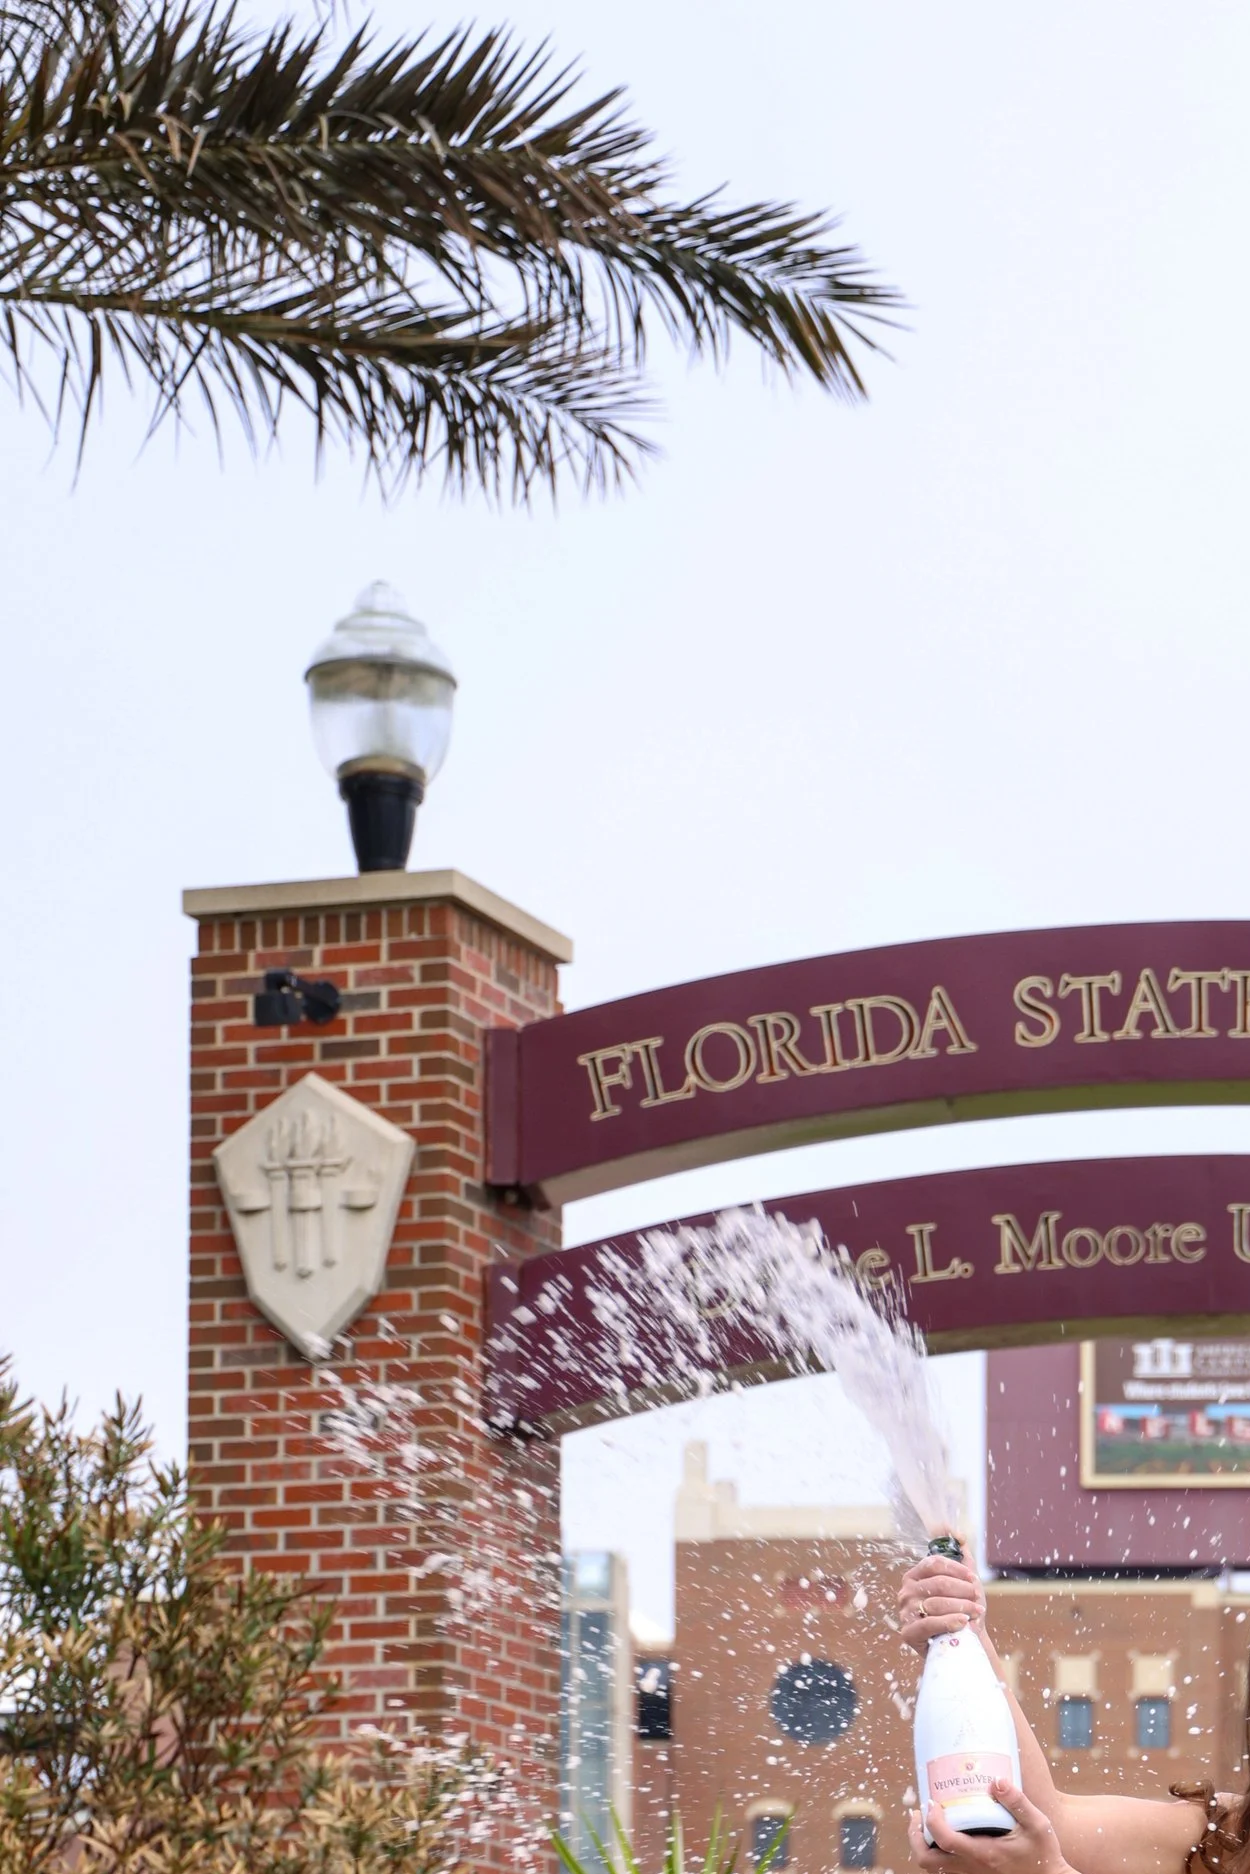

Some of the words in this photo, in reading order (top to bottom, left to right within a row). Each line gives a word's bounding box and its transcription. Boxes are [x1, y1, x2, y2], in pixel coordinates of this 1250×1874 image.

[576, 985, 979, 1123] FLORIDA
[904, 1221, 975, 1285] L.
[991, 1210, 1207, 1277] Moore
[933, 1777, 961, 1791] VEUVE
[974, 1773, 996, 1784] VER
